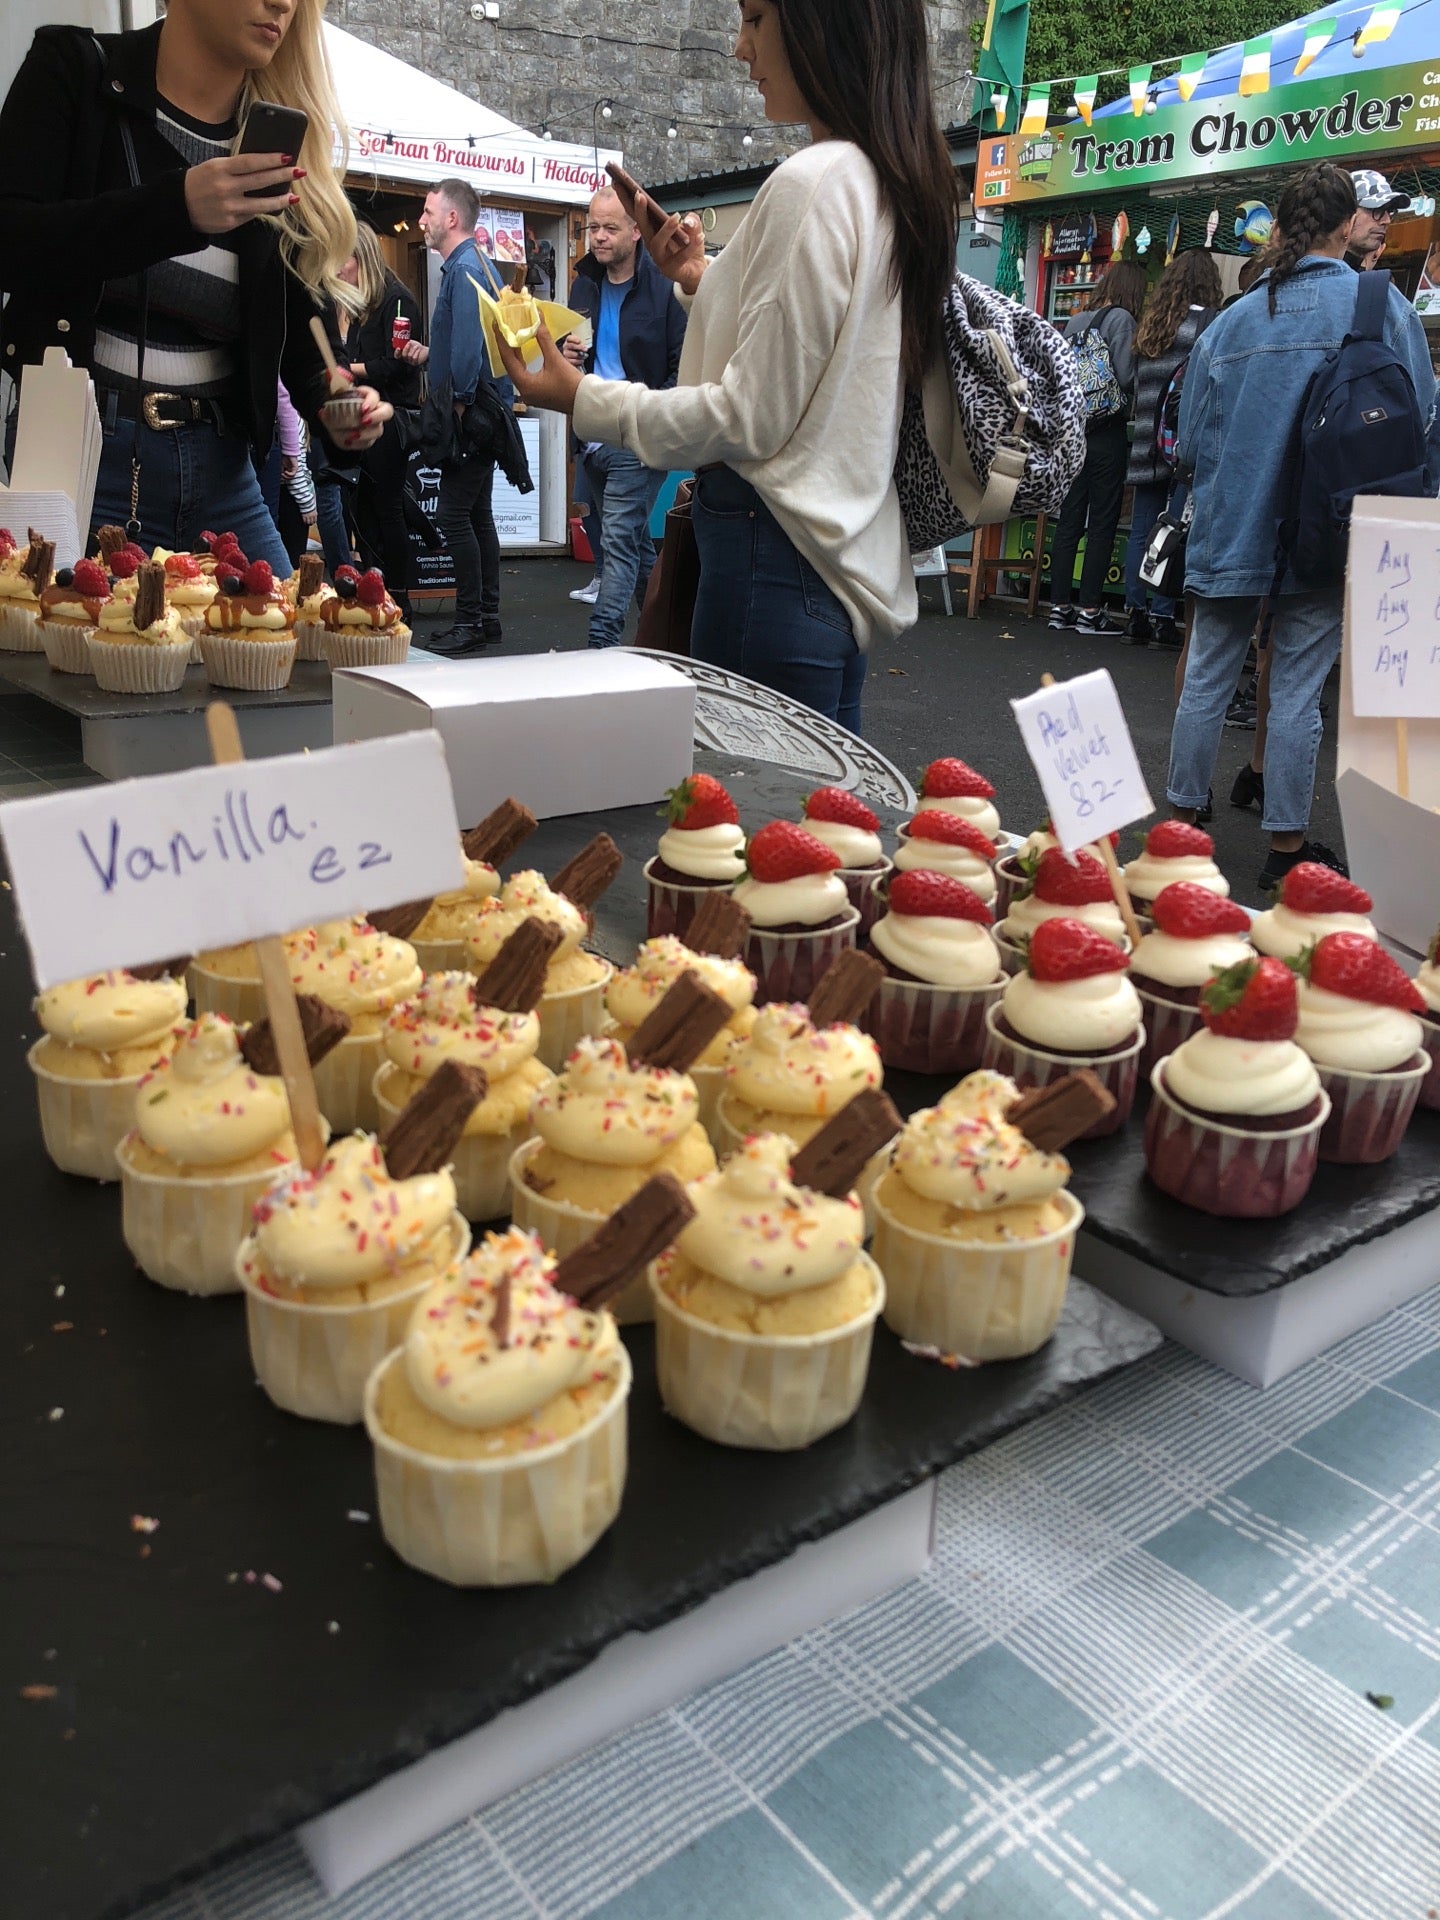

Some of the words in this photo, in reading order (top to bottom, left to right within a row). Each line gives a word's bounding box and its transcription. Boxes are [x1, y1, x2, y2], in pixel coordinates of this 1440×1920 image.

[1070, 132, 1175, 176] Tram
[1189, 90, 1414, 157] Chowder
[543, 158, 606, 193] Hotdogs
[985, 169, 1002, 178] Follow
[1376, 540, 1412, 589] Any
[1376, 592, 1410, 636] Any
[1375, 645, 1409, 688] Any
[703, 714, 816, 757] 2010
[1037, 692, 1084, 748] Red
[1053, 724, 1111, 782] Velvet
